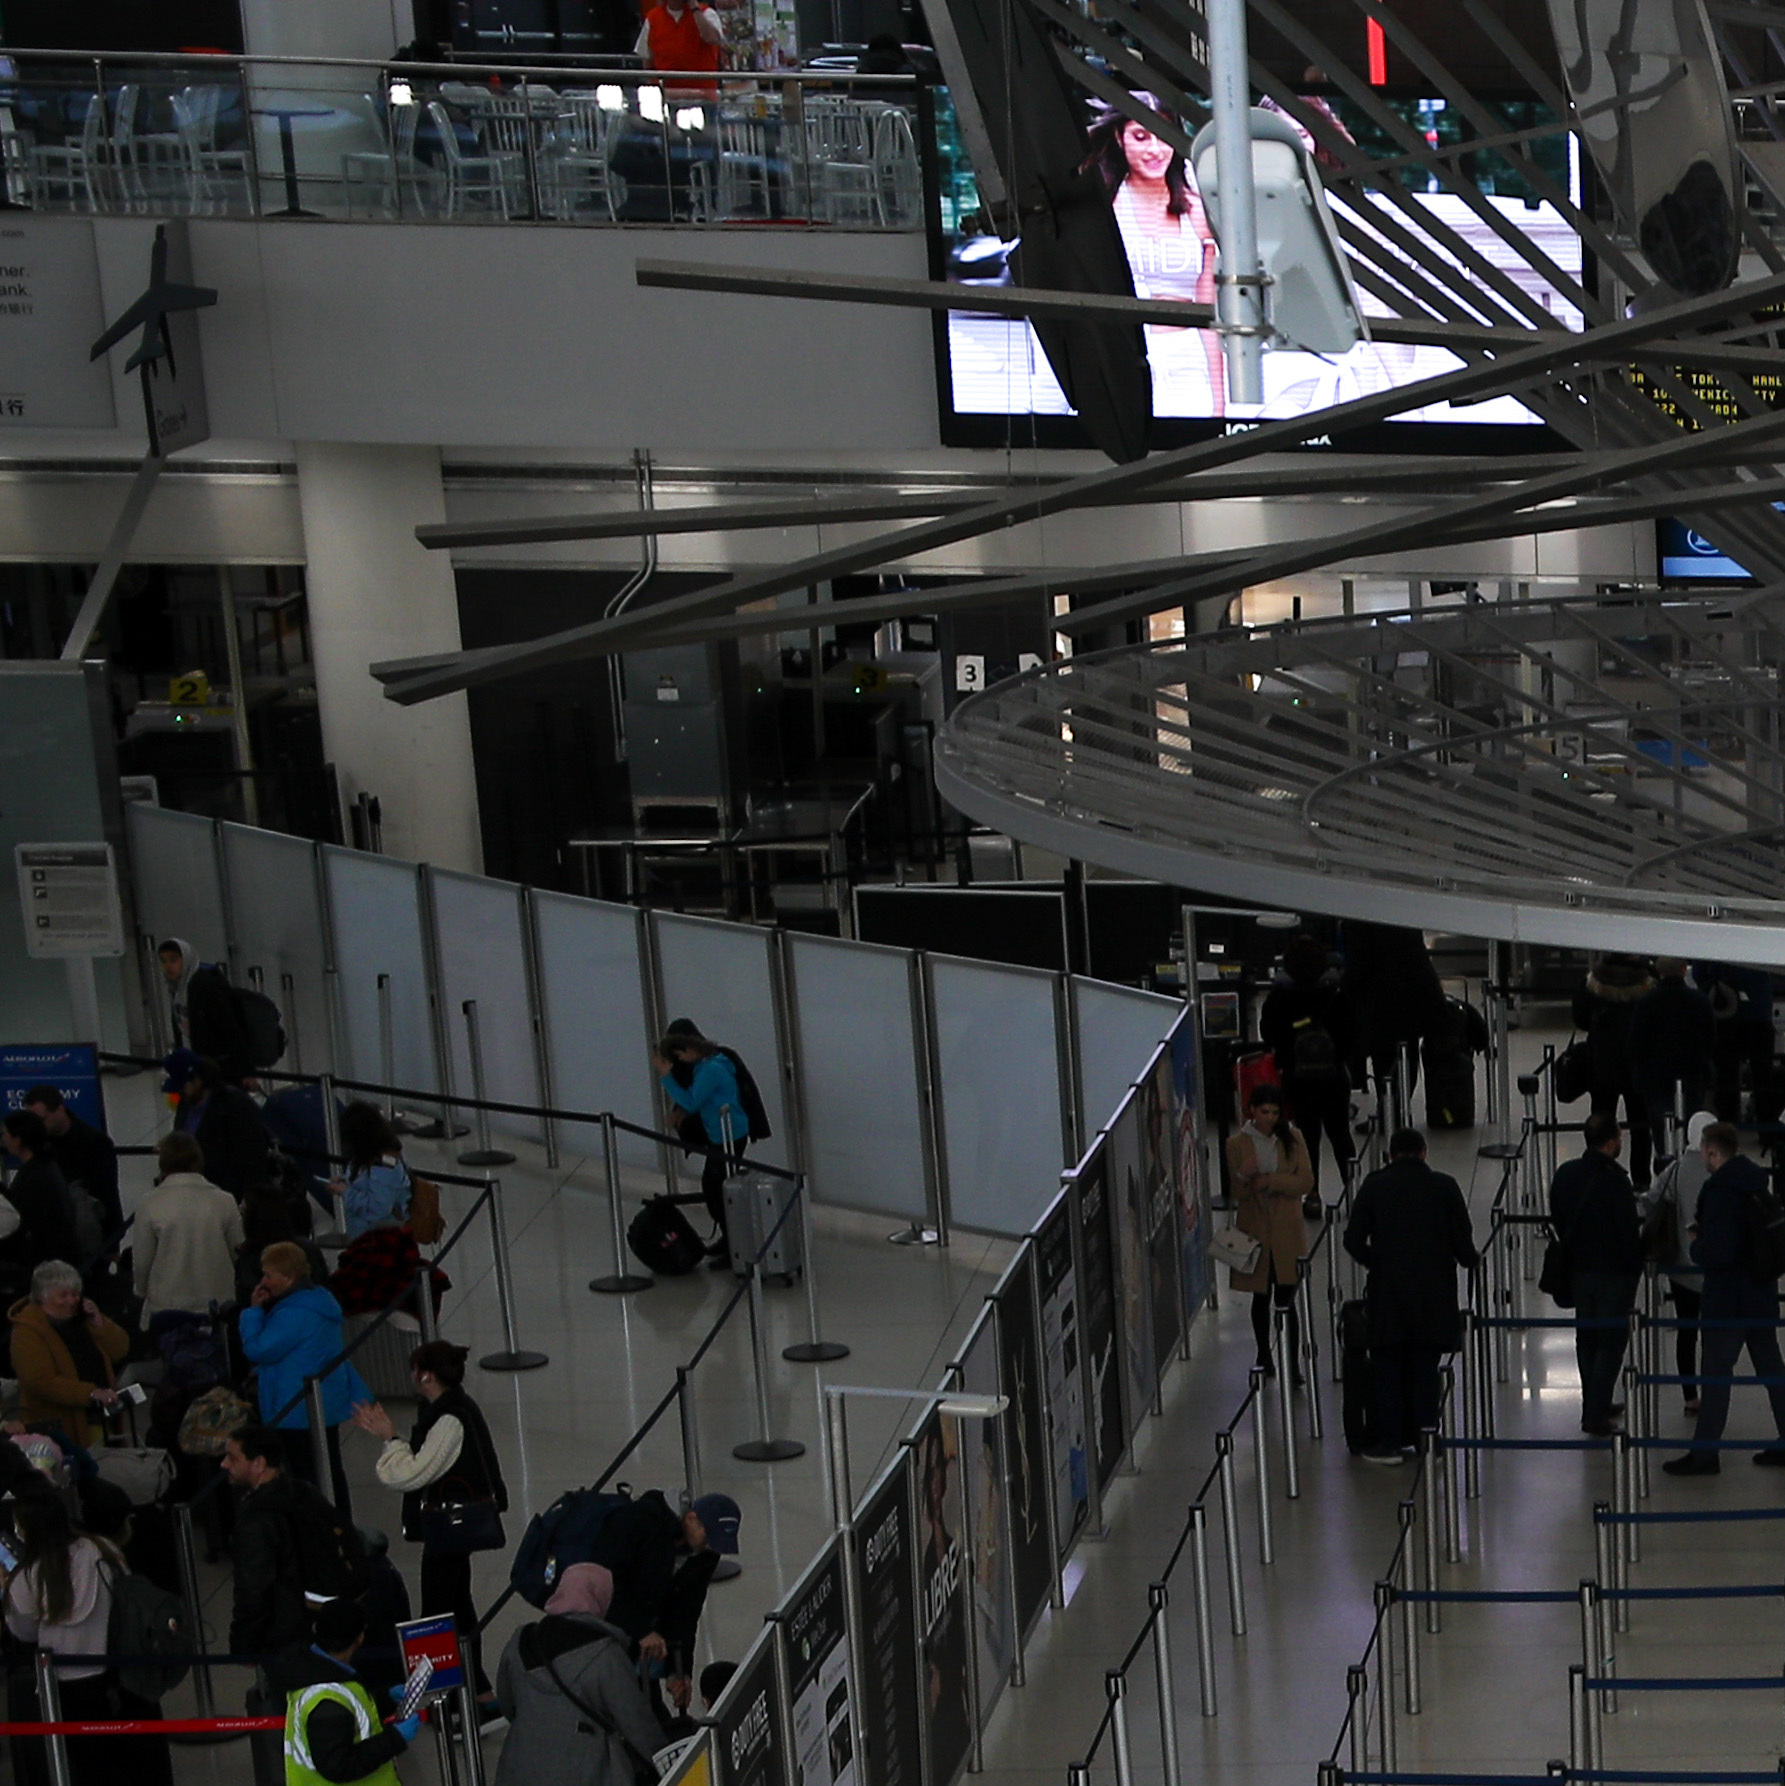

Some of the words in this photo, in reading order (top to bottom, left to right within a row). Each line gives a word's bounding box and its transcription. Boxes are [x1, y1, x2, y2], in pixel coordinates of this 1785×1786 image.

[964, 665, 977, 683] 3
[178, 681, 198, 701] 2
[6, 1088, 81, 1099] ECMY
[924, 1545, 961, 1637] LIBRE
